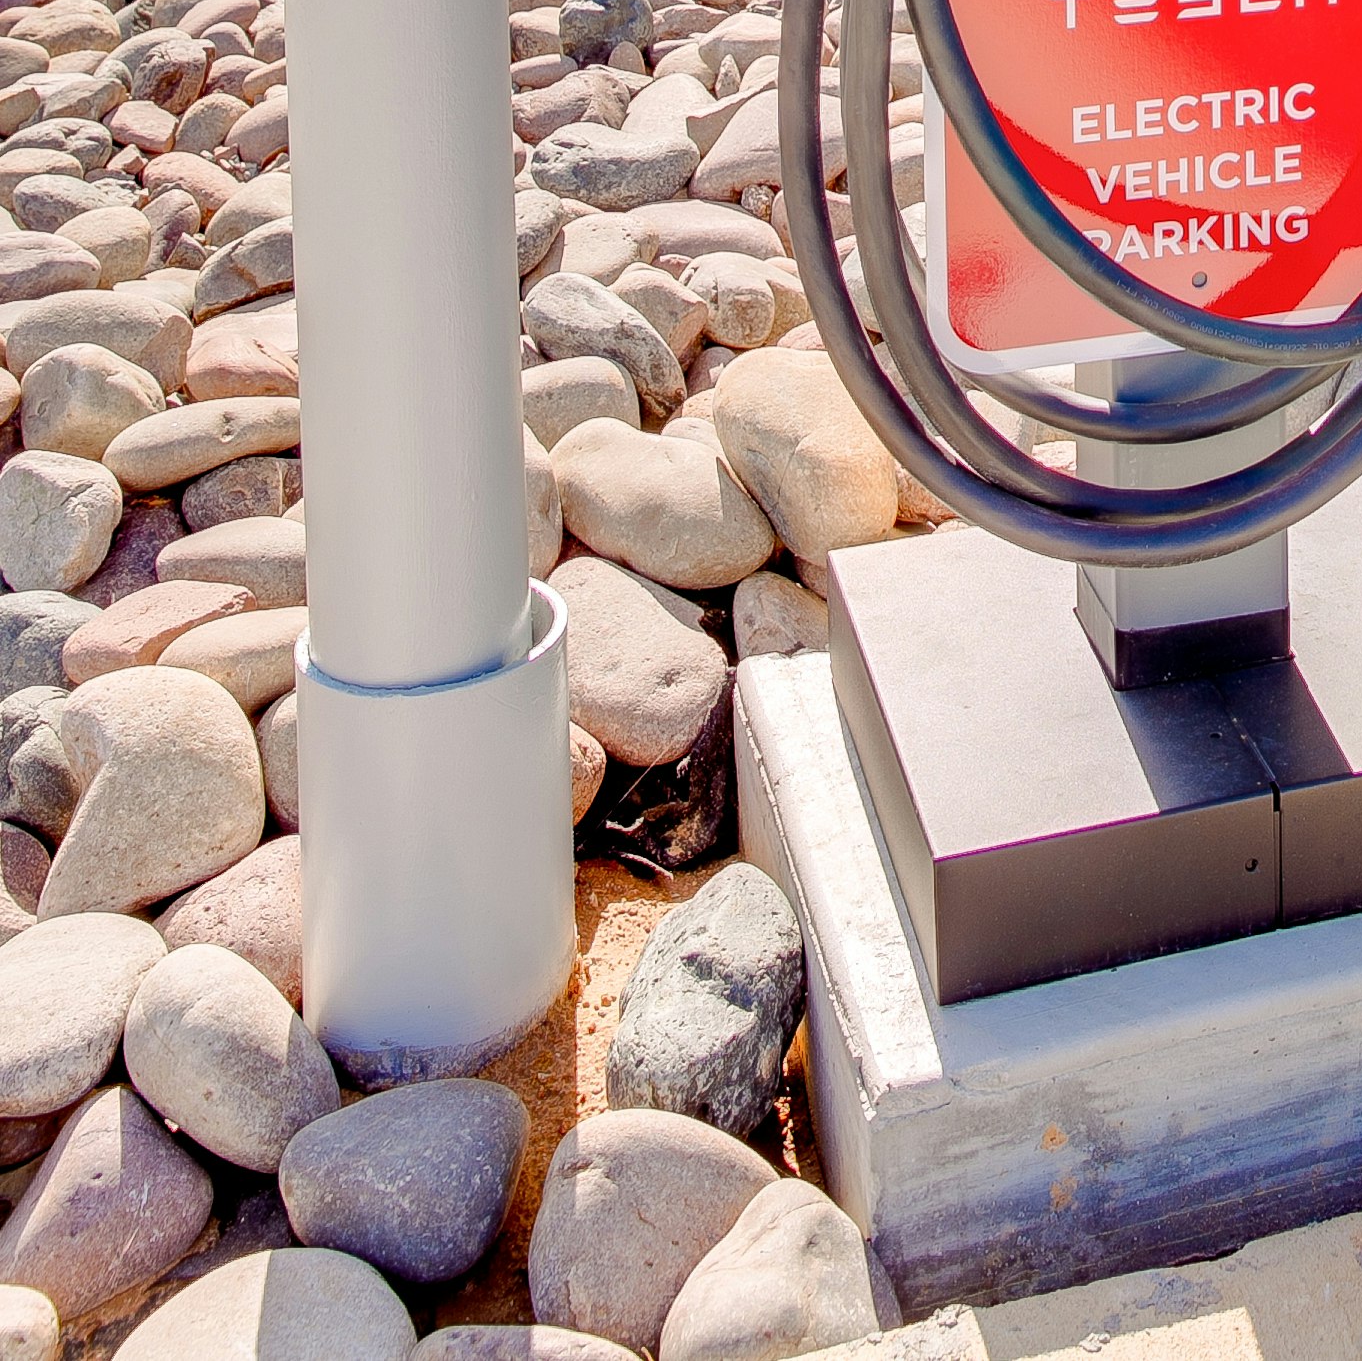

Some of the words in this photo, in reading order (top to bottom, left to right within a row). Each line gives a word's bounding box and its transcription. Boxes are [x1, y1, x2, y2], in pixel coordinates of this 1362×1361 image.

[1072, 82, 1316, 144] ELECTRIC
[1087, 143, 1302, 205] VEHICLE
[1313, 342, 1330, 351] OIL
